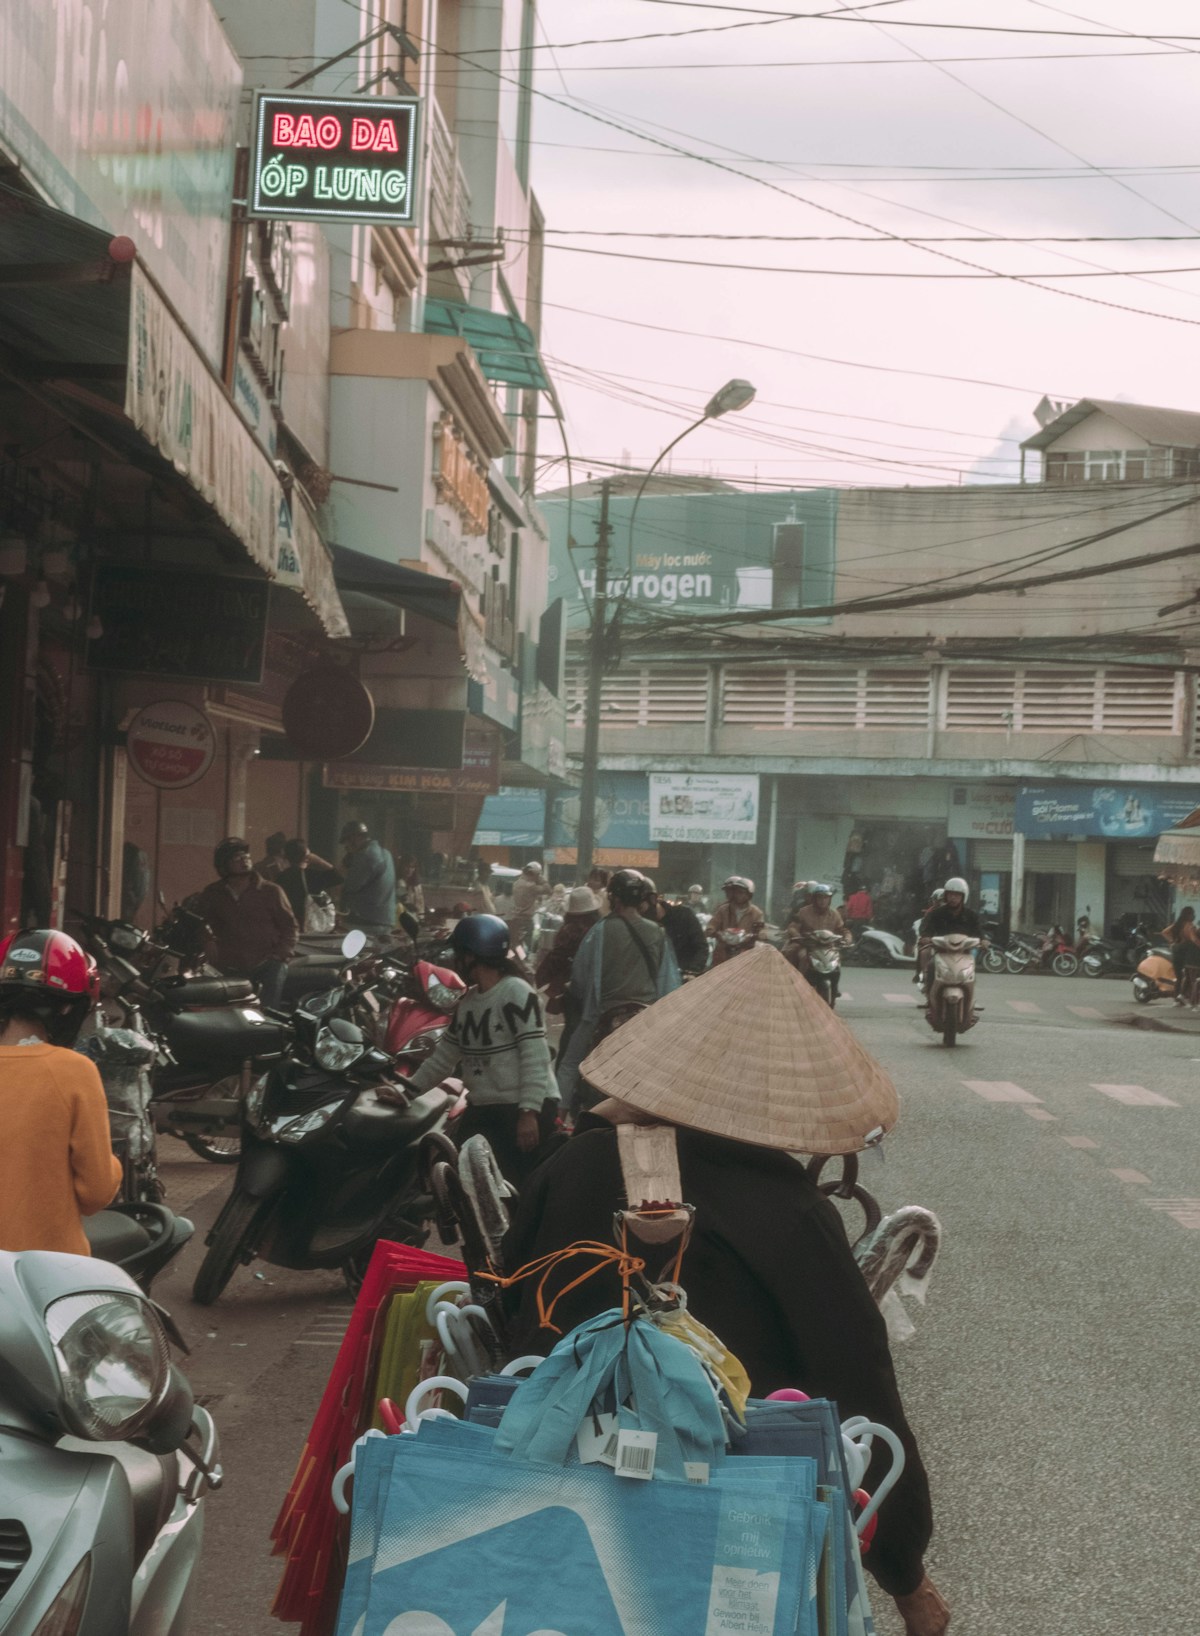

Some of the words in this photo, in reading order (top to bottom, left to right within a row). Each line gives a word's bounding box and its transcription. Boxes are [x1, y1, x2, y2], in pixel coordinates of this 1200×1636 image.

[272, 113, 342, 150] BAO
[351, 117, 399, 152] DA
[260, 153, 308, 197] ỐP
[636, 552, 661, 570] Máy
[388, 774, 417, 786] KIM
[727, 1509, 772, 1526] Gebruik
[741, 1530, 760, 1546] mij
[723, 1543, 772, 1560] opnieuw.
[725, 1577, 745, 1588] Meer
[747, 1578, 769, 1589] doen
[719, 1588, 737, 1598] voor
[738, 1588, 753, 1599] het
[712, 1608, 747, 1619] Gewoon
[720, 1619, 745, 1631] Albert
